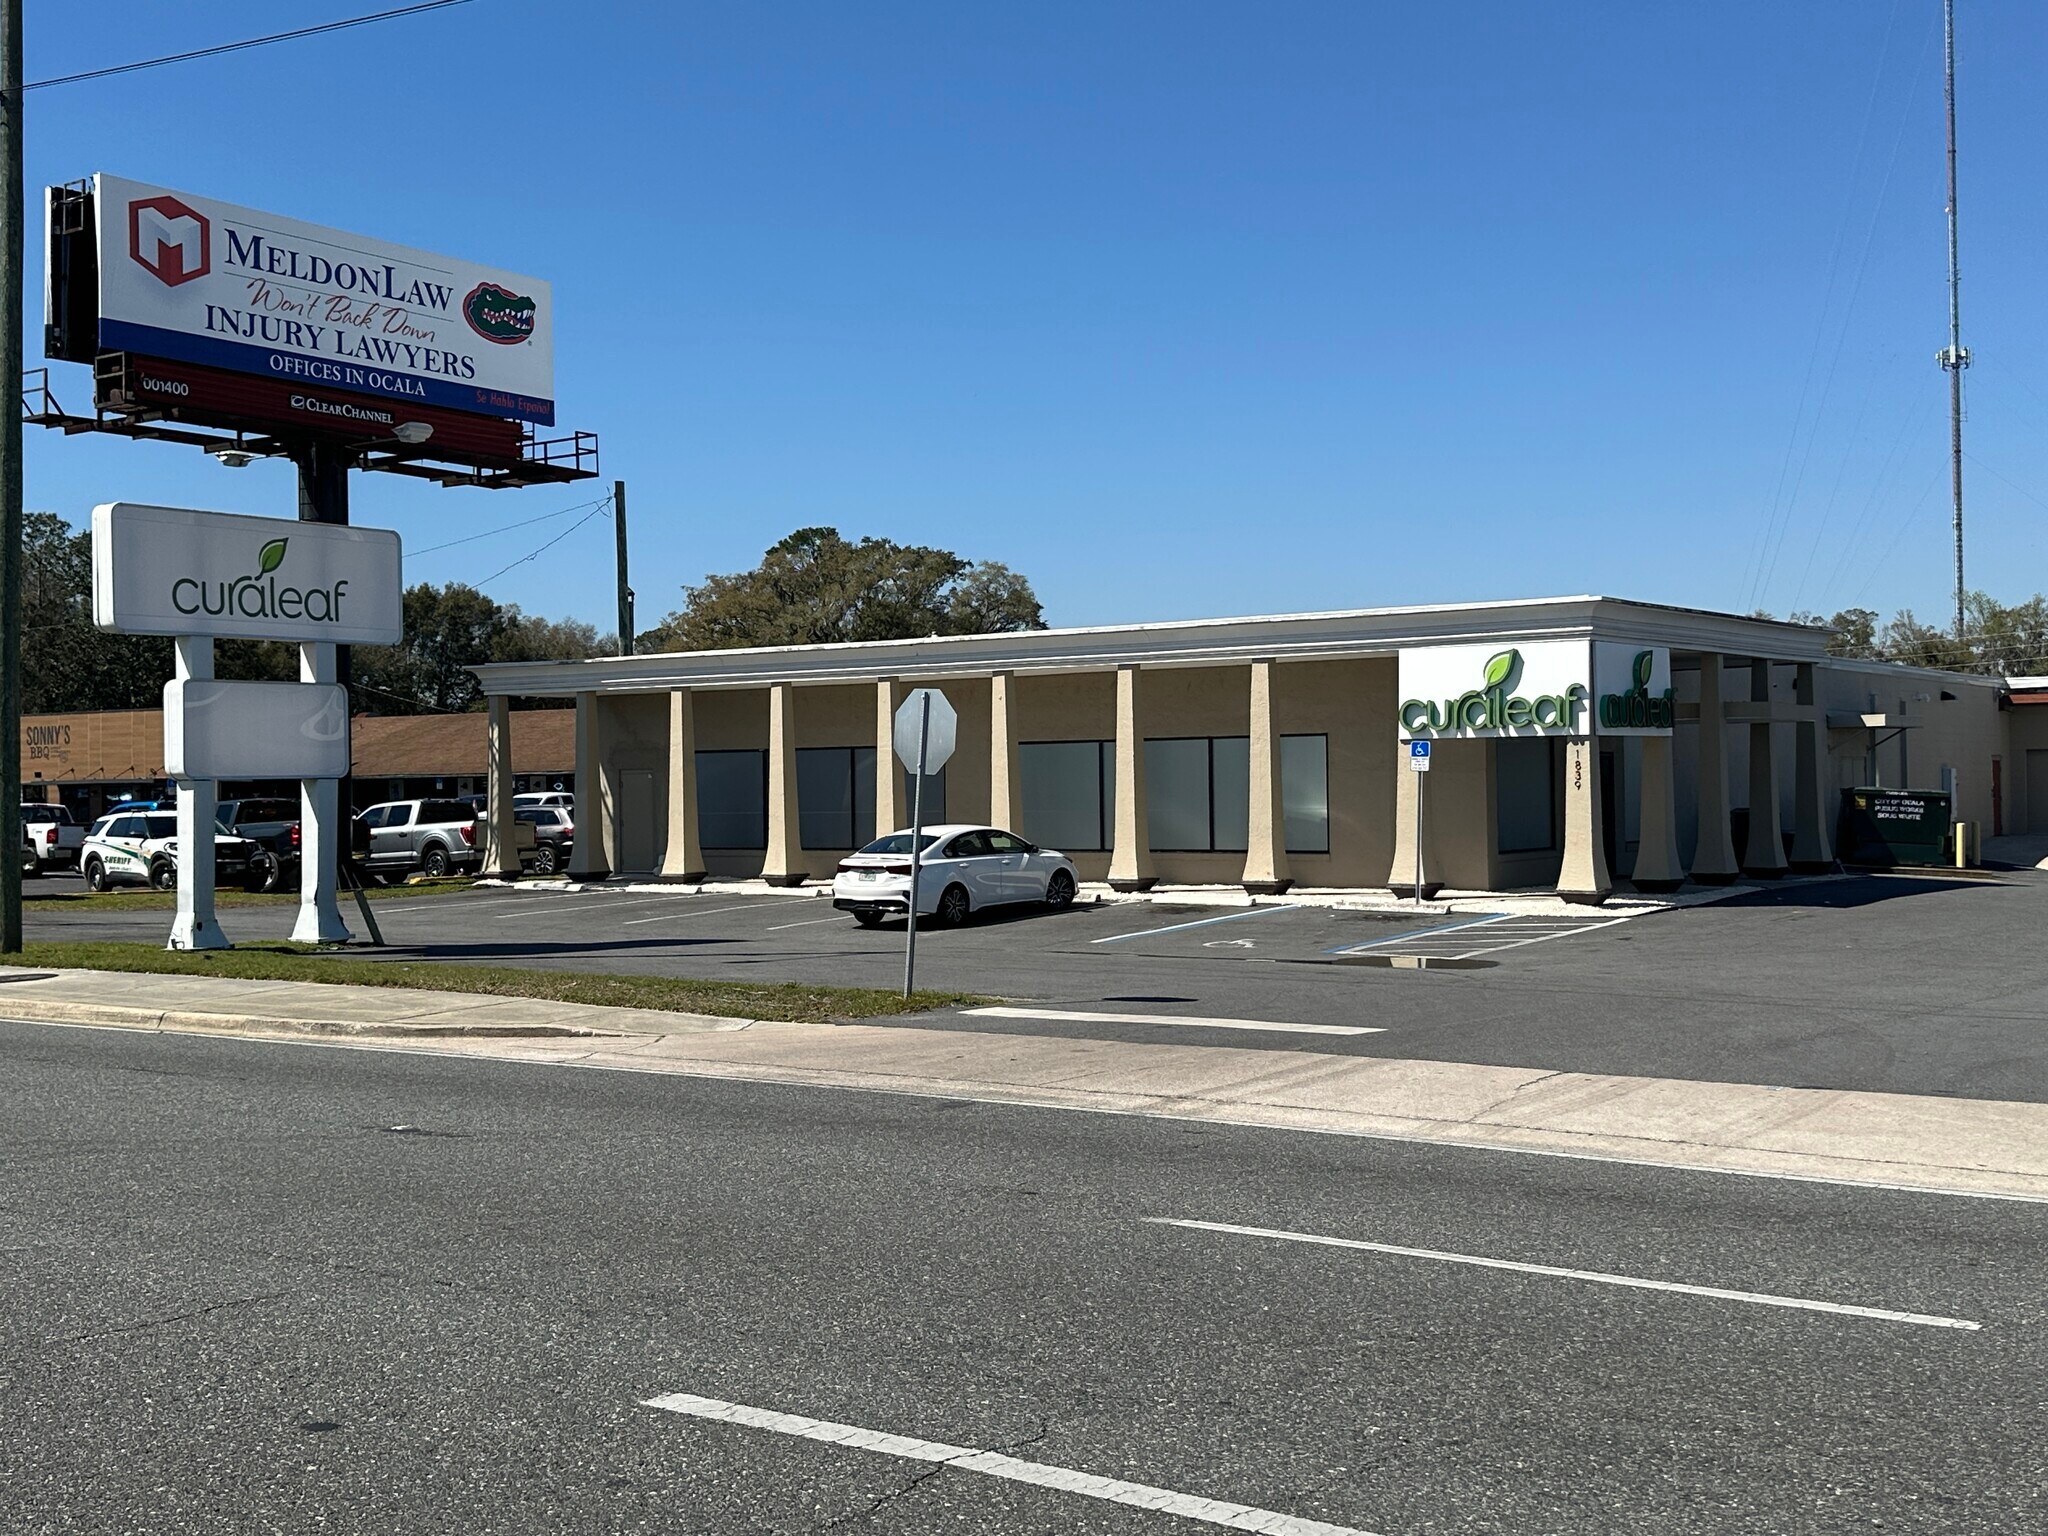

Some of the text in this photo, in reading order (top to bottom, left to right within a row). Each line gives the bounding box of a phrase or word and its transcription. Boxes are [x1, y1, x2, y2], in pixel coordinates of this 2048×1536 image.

[247, 278, 436, 342] Won't Back Down
[204, 304, 475, 379] INJURY LAWYERS
[142, 377, 189, 396] 001400
[269, 354, 426, 396] OFFICES IN OCALA
[172, 575, 349, 622] curaleaf
[1399, 683, 1585, 733] curaleaf
[26, 725, 71, 746] SONNY'S
[30, 746, 50, 760] BBQ
[1574, 749, 1582, 791] 1839
[104, 856, 132, 865] SHERIFF
